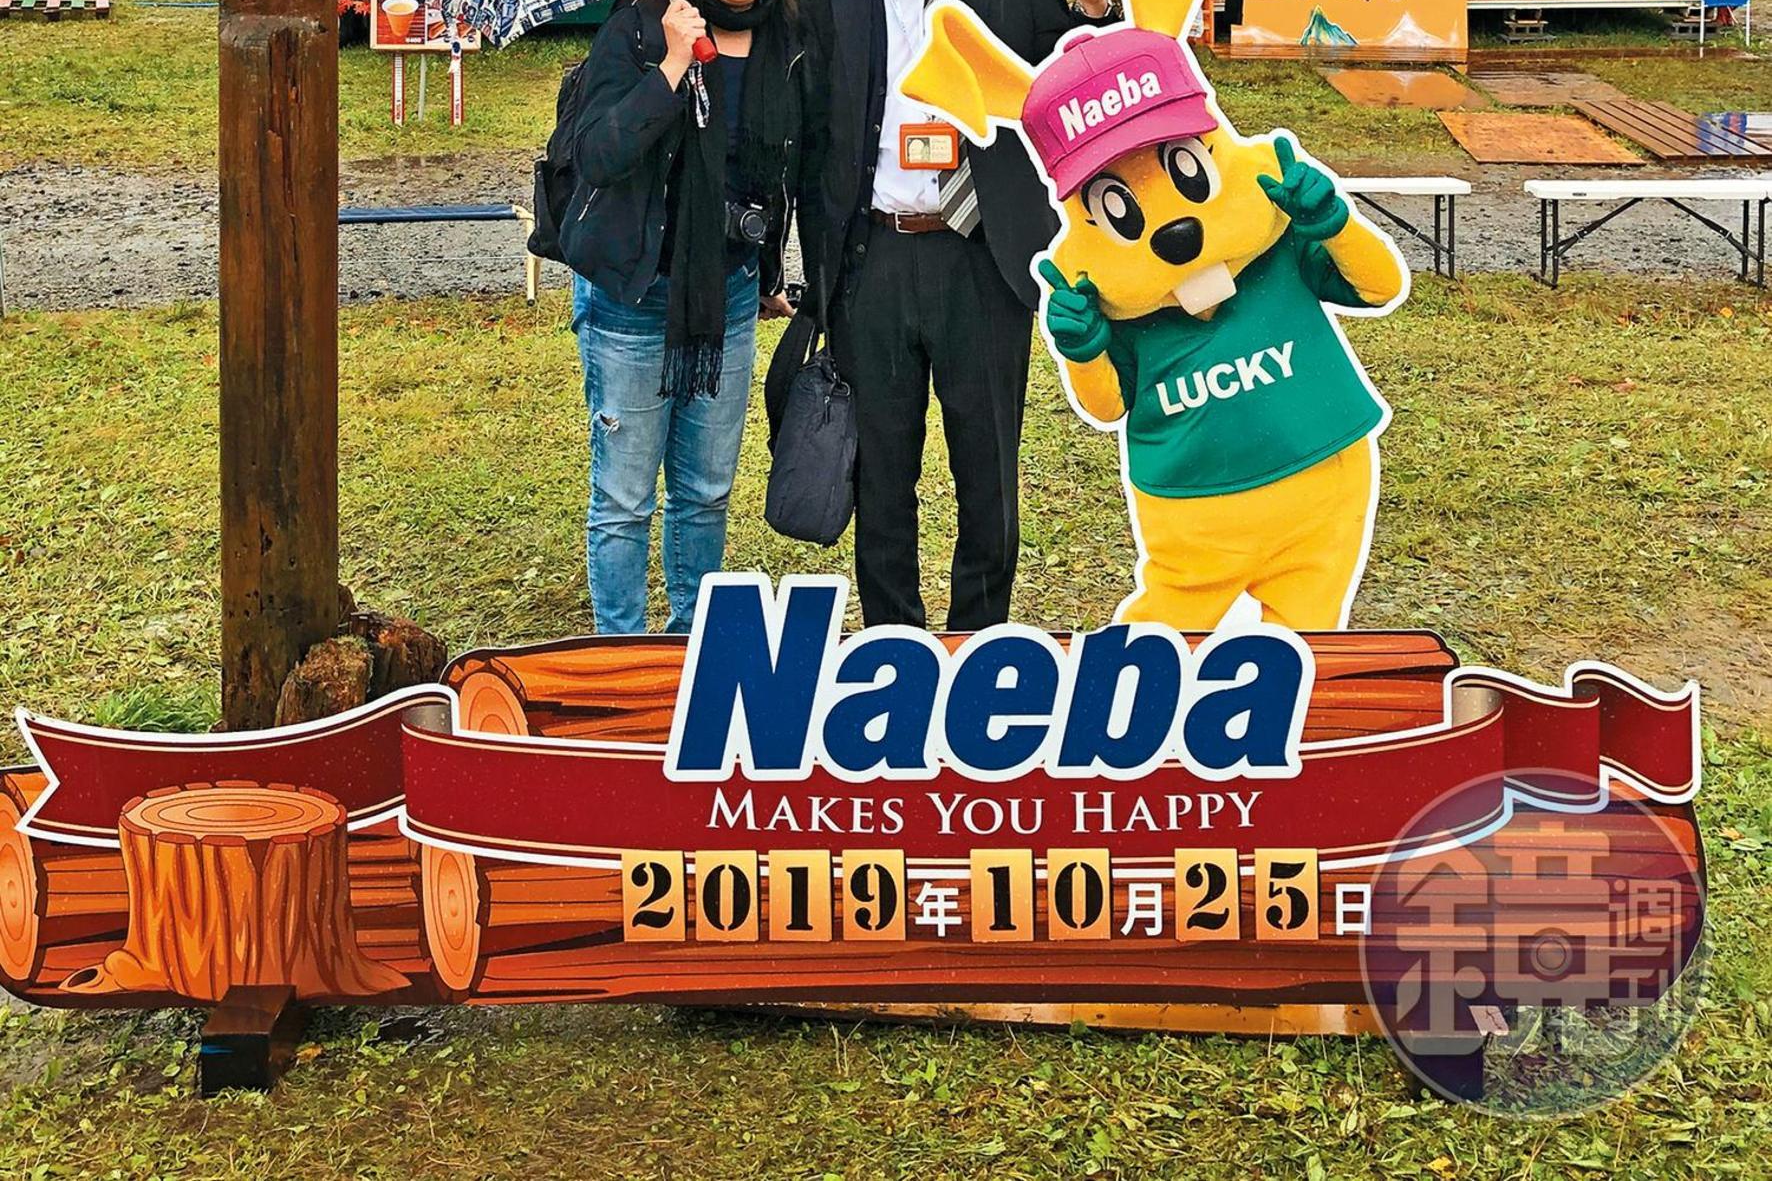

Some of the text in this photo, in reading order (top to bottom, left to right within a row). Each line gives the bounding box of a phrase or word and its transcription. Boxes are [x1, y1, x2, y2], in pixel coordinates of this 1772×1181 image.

[1058, 69, 1162, 142] Naeba
[1155, 340, 1295, 417] LUCKY
[673, 583, 1303, 773] Naeba
